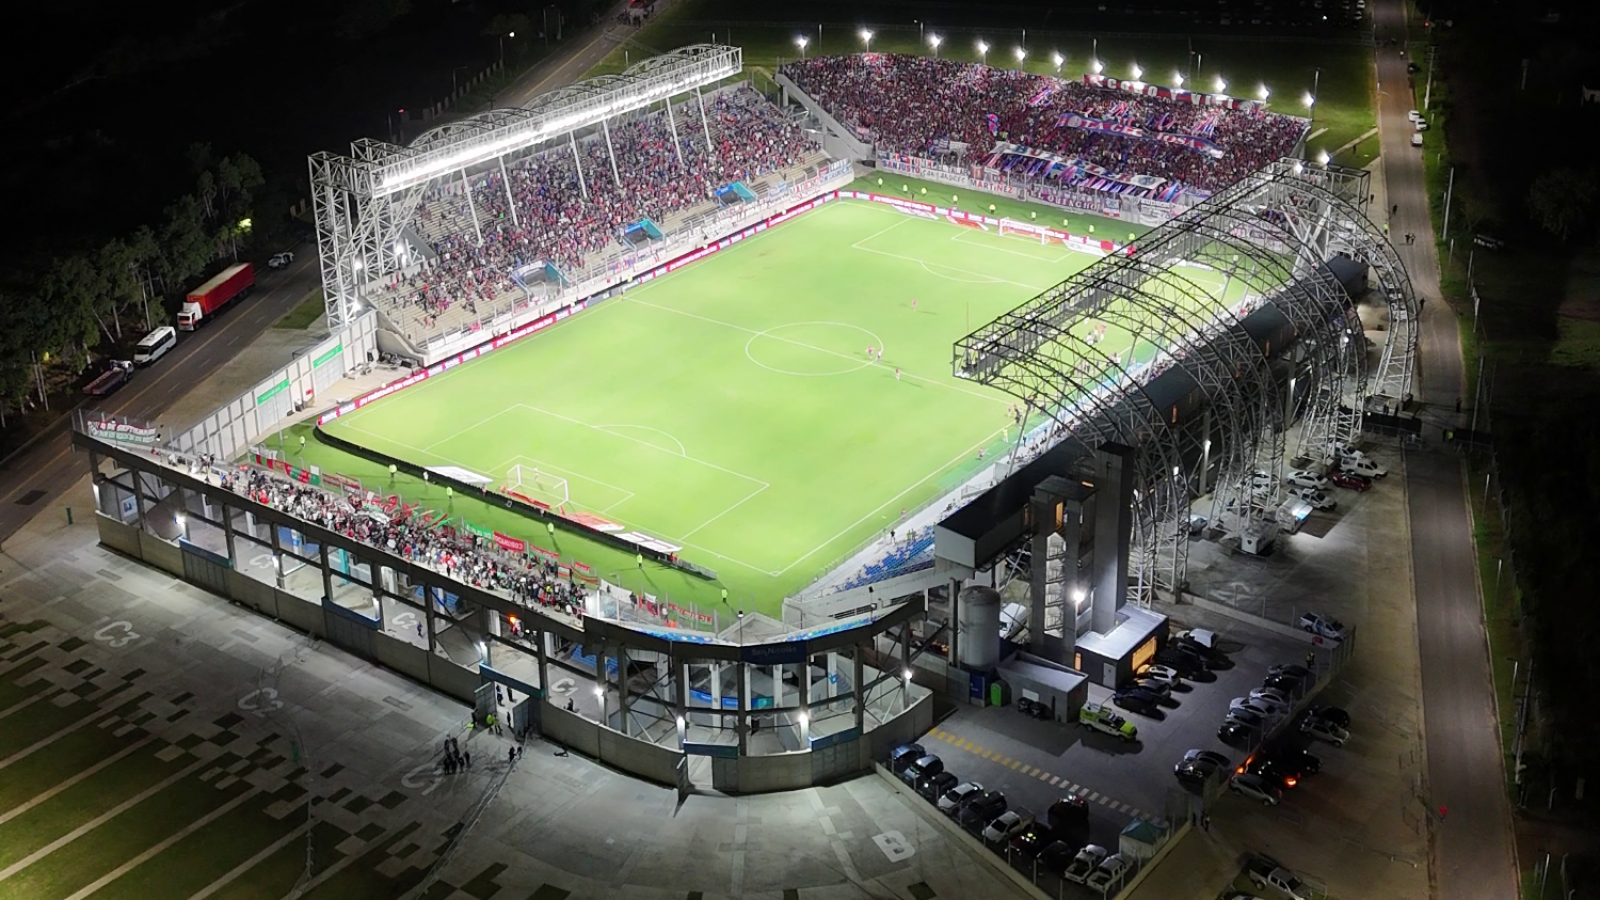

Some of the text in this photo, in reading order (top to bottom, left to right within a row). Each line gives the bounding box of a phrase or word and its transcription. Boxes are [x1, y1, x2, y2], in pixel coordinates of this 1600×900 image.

[392, 612, 418, 630] C2
[94, 620, 141, 648] C3
[551, 677, 579, 697] C1
[238, 686, 285, 717] C2
